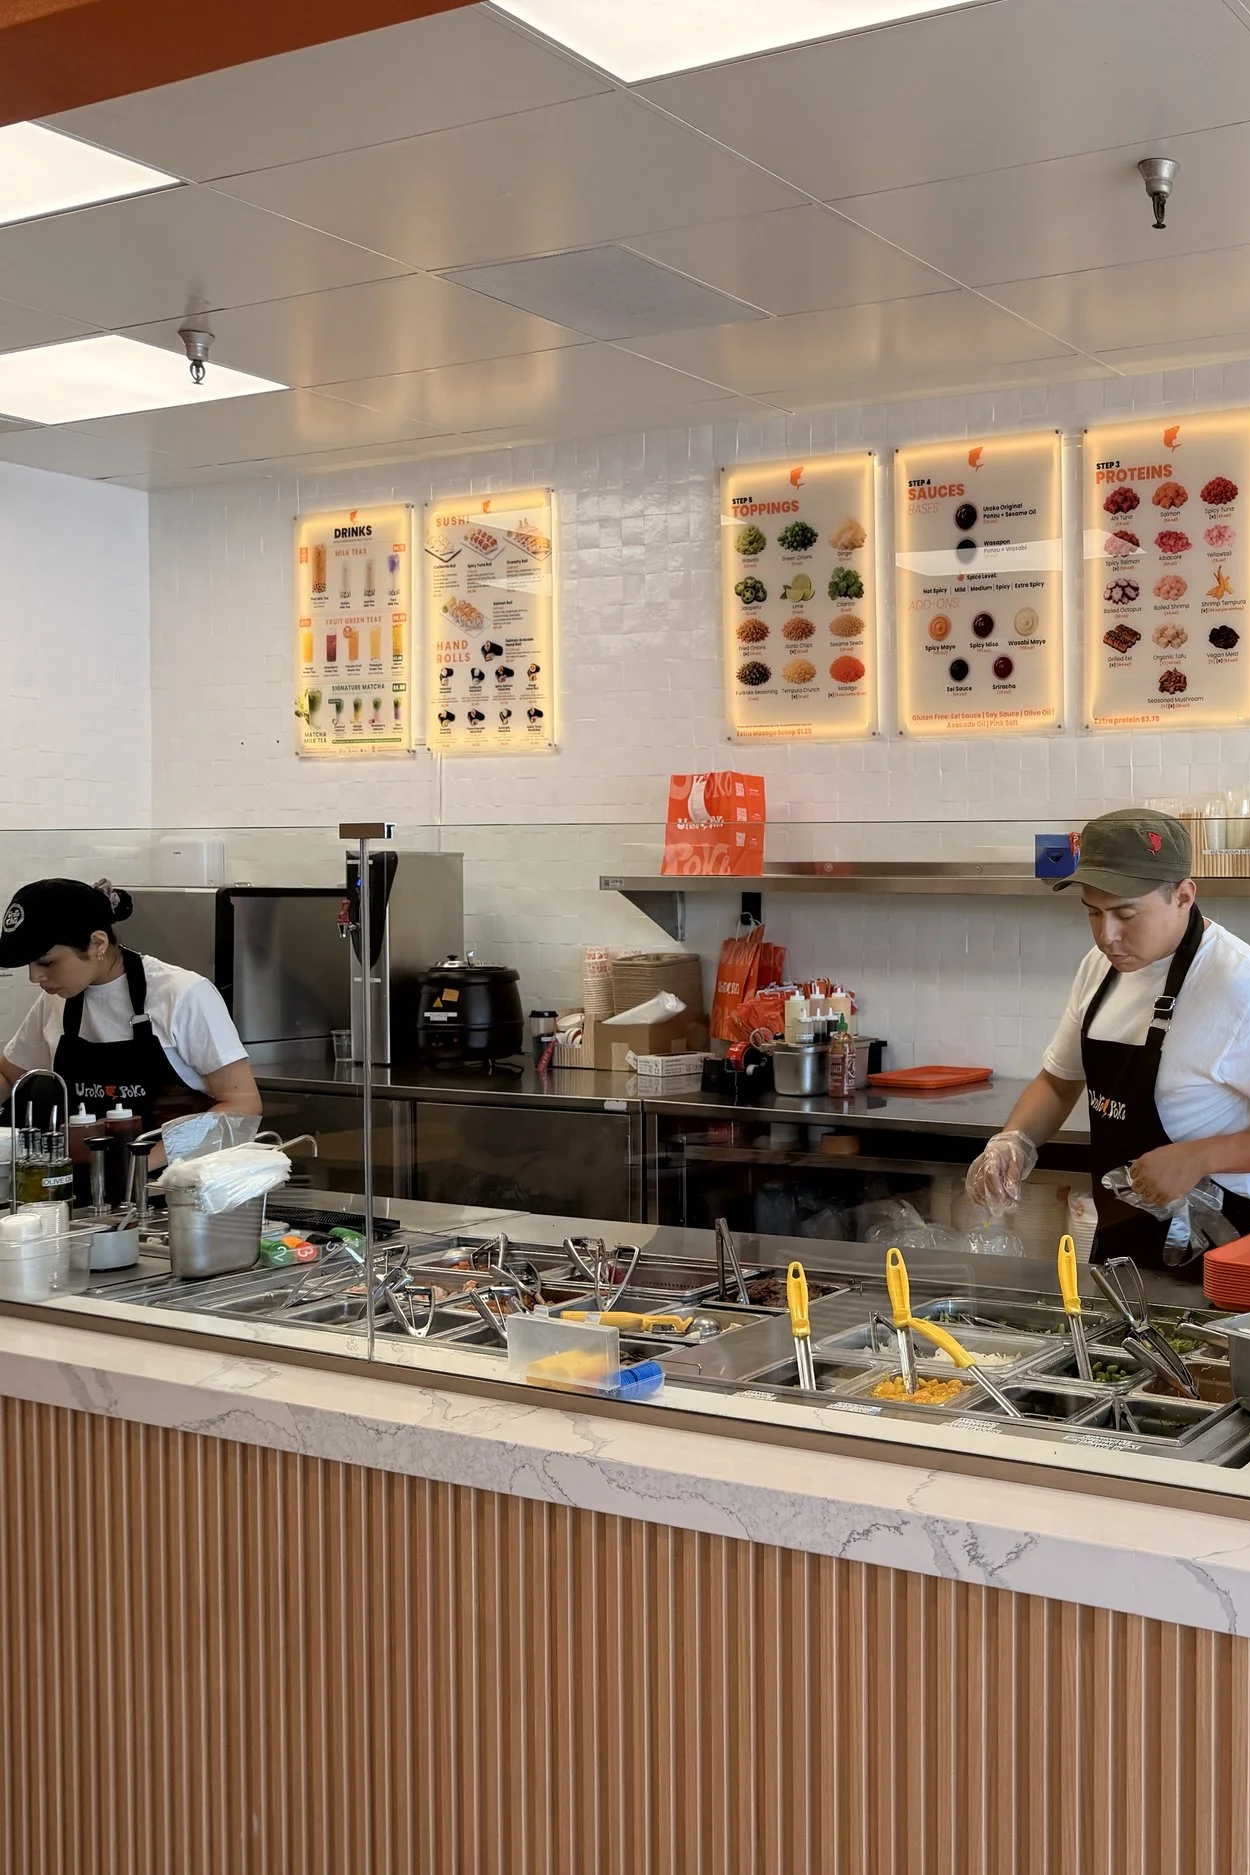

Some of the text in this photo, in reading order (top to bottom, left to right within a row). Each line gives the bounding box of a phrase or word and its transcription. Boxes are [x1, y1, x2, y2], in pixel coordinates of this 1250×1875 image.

[1096, 460, 1121, 470] STEP 3
[1095, 463, 1173, 484] PROTEINS
[908, 478, 931, 488] STEP 4
[908, 483, 965, 501] SAUCES
[731, 500, 799, 517] TOPPINGS
[908, 502, 939, 516] BASES
[1000, 502, 1023, 512] Original
[983, 512, 1000, 520] Ponzu
[1028, 508, 1037, 516] Oil
[333, 525, 372, 539] DRINKS
[983, 539, 1011, 547] Wasapon
[1120, 558, 1140, 566] Salmon
[995, 583, 1011, 591] Spicy
[1014, 582, 1029, 590] Extra
[1029, 581, 1045, 589] Spicy
[908, 598, 960, 611] ADD-ONS
[436, 640, 468, 651] HAND
[969, 642, 985, 650] Spicy
[1030, 638, 1046, 646] Mayo
[940, 644, 956, 652] Mayo
[436, 653, 471, 663] ROLLS
[1174, 695, 1204, 703] Mushroom
[42, 1176, 64, 1187] OLIVE
[272, 1246, 287, 1262] 2
